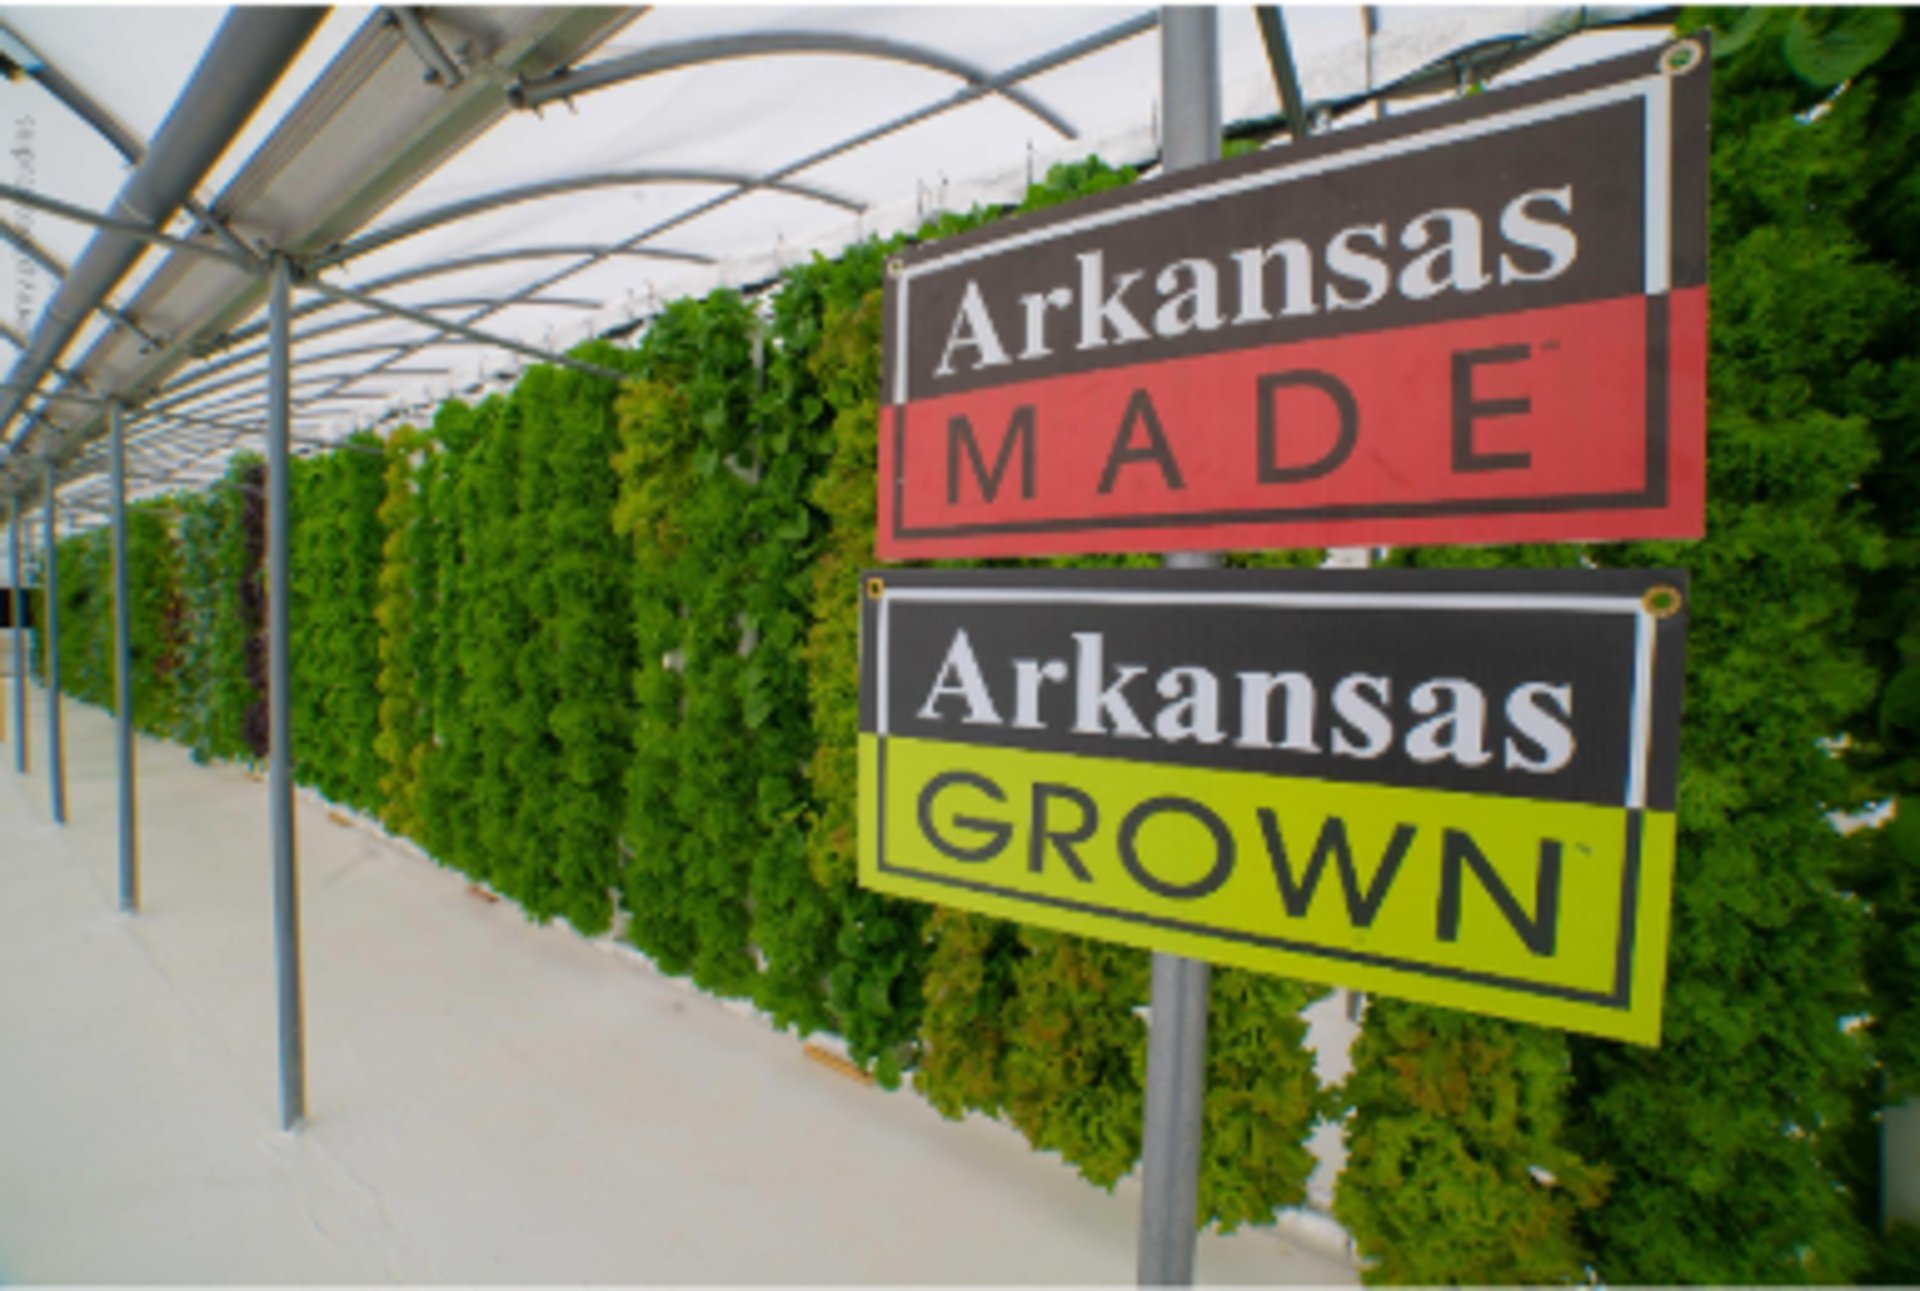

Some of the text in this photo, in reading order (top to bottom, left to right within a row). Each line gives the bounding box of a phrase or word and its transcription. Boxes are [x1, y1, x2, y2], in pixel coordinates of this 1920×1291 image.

[935, 184, 1577, 376] Arkansas
[947, 344, 1532, 505] MADE
[917, 628, 1575, 773] Arkansas
[917, 771, 1563, 958] GROWN
